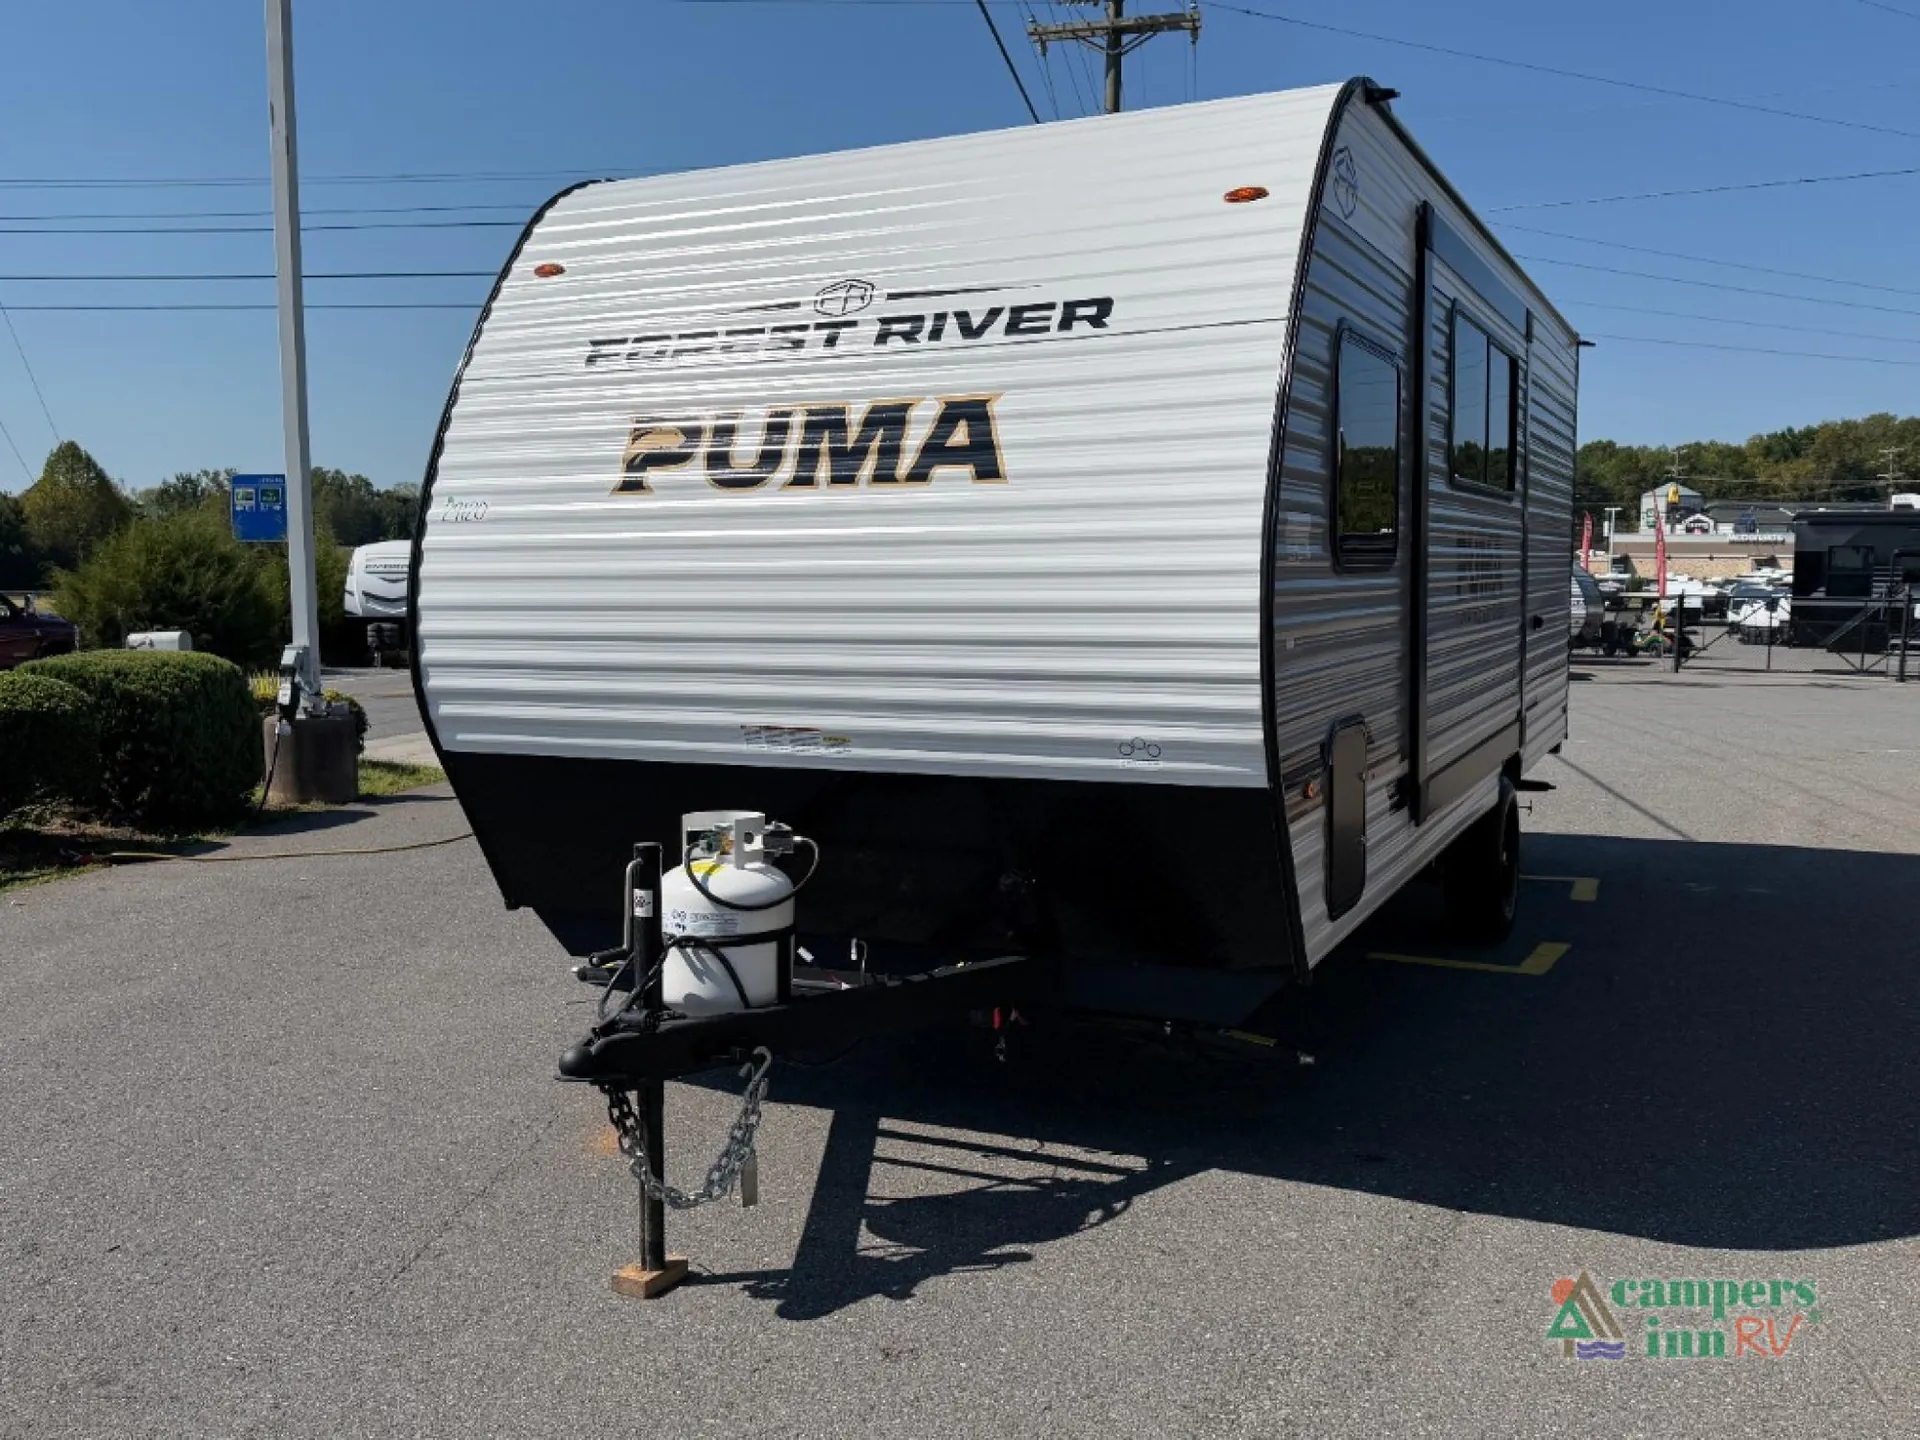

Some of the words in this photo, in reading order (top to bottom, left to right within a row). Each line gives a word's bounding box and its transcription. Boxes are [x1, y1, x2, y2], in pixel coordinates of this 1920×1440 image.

[585, 319, 859, 367] FOREST
[874, 296, 1114, 347] RIVER
[610, 392, 1009, 497] PUMA
